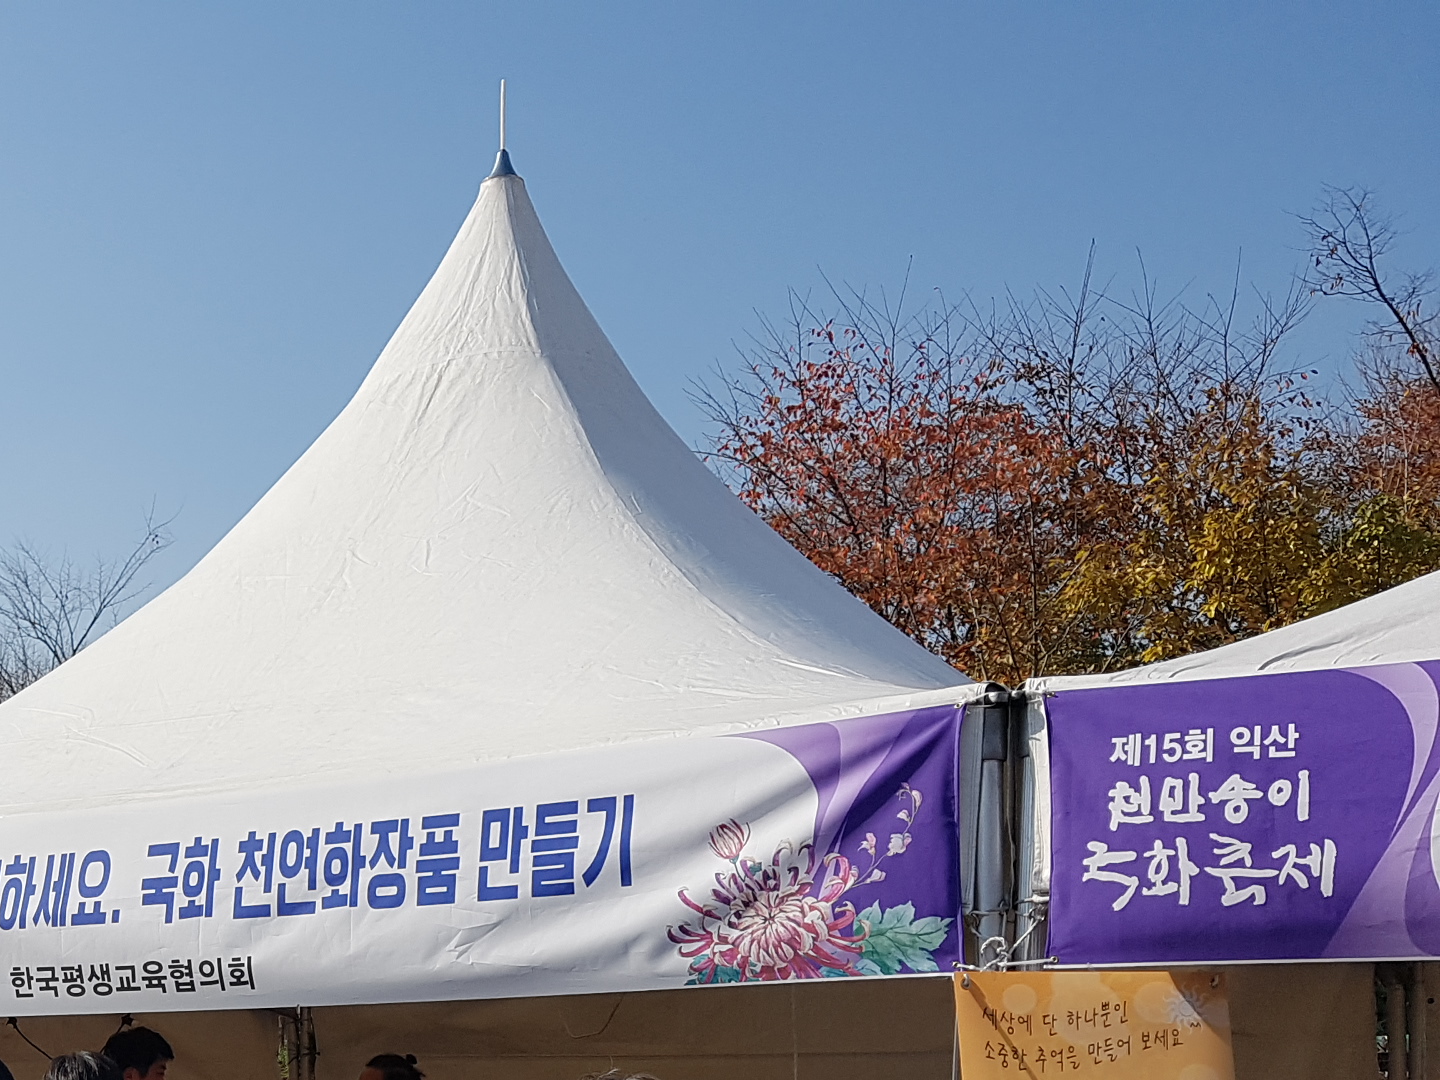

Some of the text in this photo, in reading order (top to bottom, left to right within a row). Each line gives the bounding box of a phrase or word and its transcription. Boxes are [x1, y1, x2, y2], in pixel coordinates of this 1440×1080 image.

[1109, 722, 1300, 767] 제15회 익산
[1107, 768, 1311, 832] 천만송이
[140, 835, 222, 924] 국화
[232, 811, 462, 921] 천연화장품
[476, 793, 636, 902] 만들기
[1082, 832, 1338, 912] 국화축제
[9, 955, 256, 1000] 한국평생교육협의회
[982, 1000, 1129, 1037] 세상에 단 하나뿐인
[984, 1040, 1028, 1072] 소중한
[1035, 1045, 1081, 1073] 추억을
[1087, 1034, 1132, 1065] 만들어
